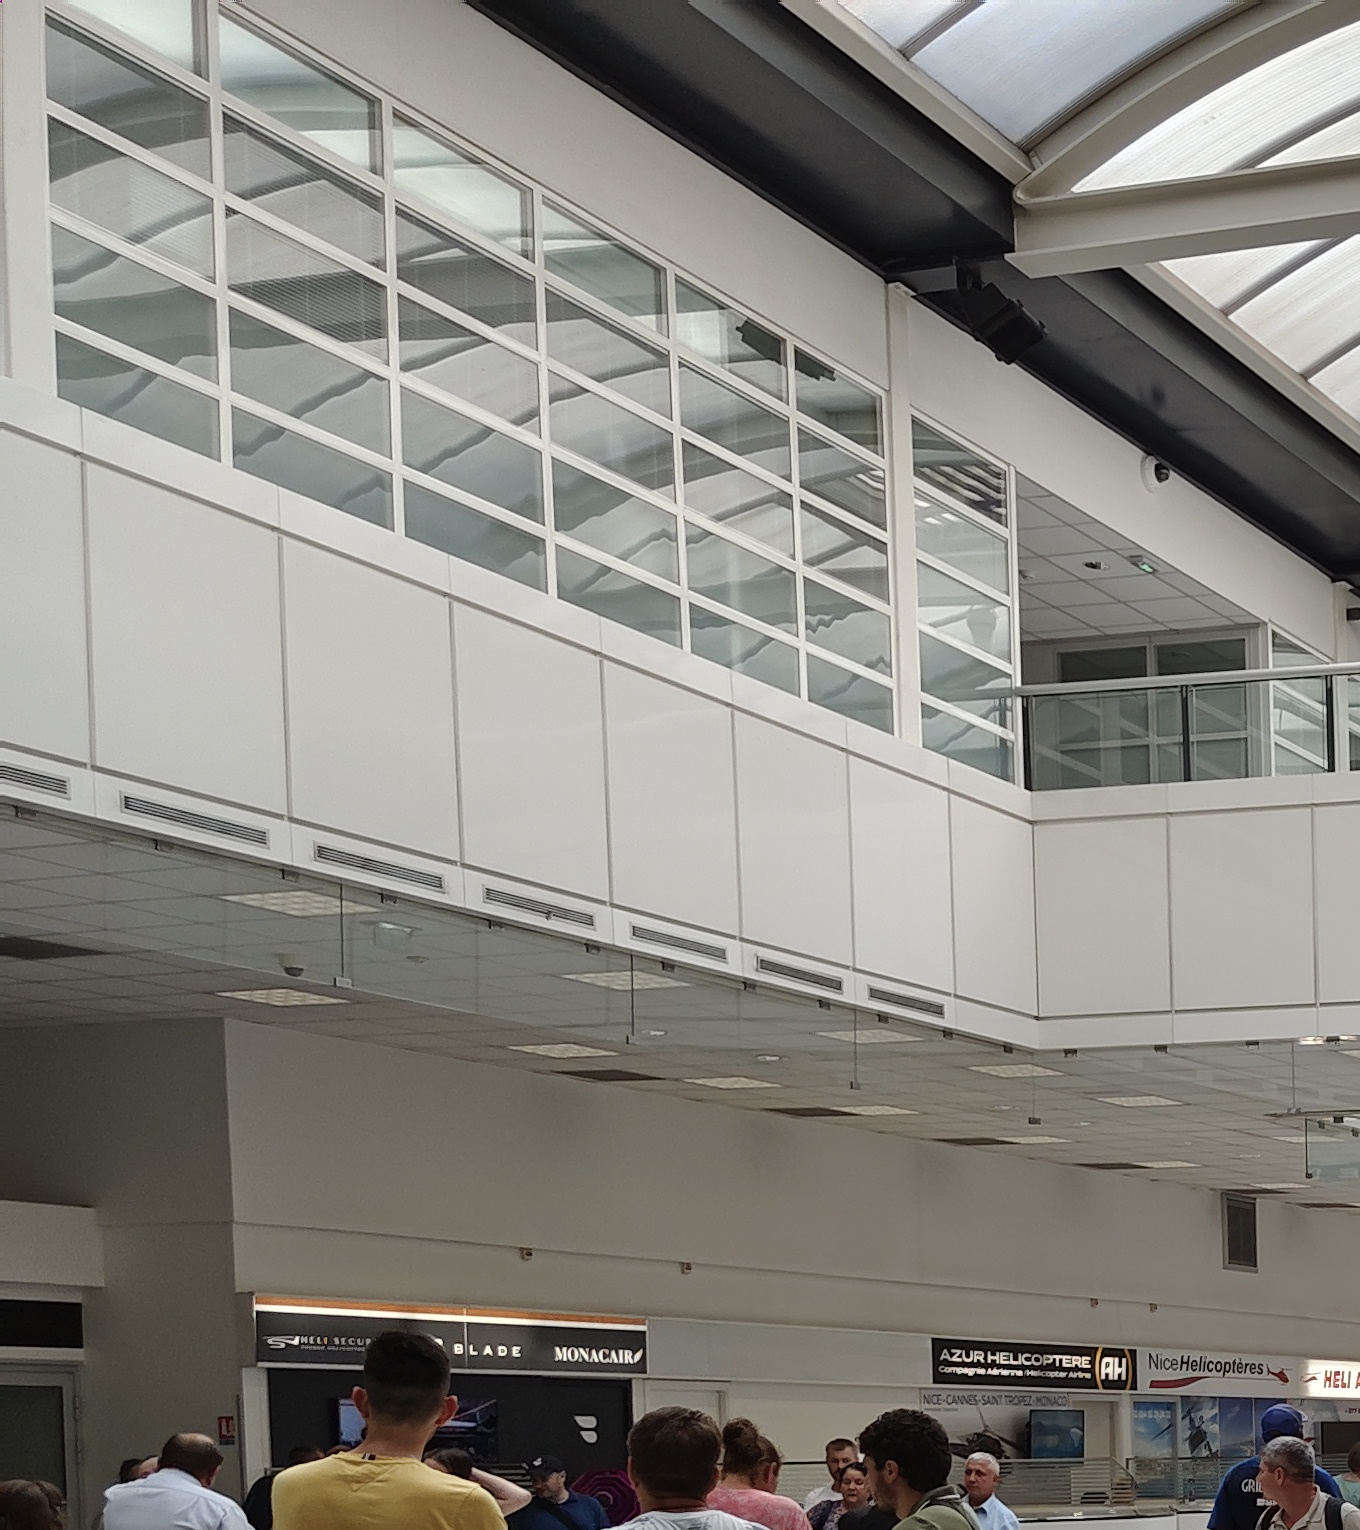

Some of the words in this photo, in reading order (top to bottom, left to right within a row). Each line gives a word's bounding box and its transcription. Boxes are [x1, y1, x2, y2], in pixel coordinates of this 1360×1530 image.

[453, 1343, 522, 1359] BLADE
[554, 1345, 637, 1365] MONACAIR
[939, 1348, 985, 1364] AZUR
[987, 1351, 1092, 1369] HELICOPTERE
[938, 1365, 986, 1378] Compagnie
[1101, 1356, 1127, 1381] AH
[1323, 1369, 1351, 1390] HELI
